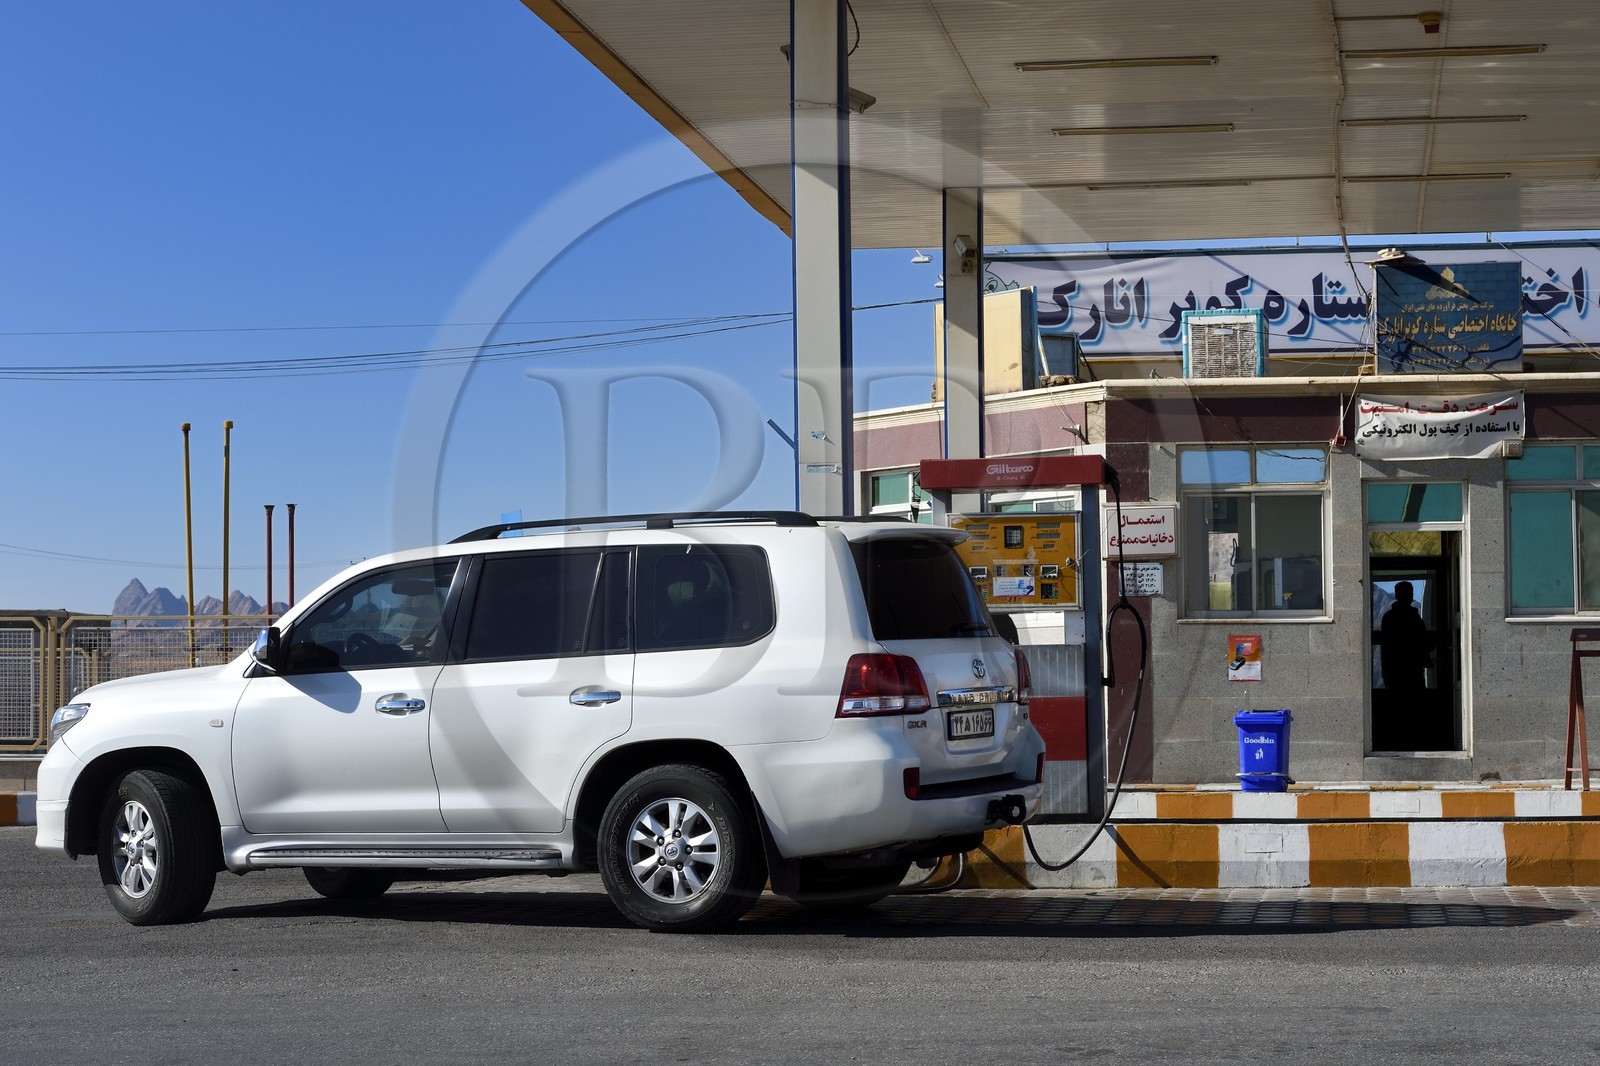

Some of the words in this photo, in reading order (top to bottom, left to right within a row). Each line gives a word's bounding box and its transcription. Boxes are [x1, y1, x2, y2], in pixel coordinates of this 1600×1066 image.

[1263, 272, 1367, 334] ستاره
[1402, 304, 1414, 313] ایران
[1426, 303, 1435, 312] های
[1423, 315, 1446, 340] ستاره
[1448, 313, 1488, 339] اختصاصی
[1490, 313, 1517, 336] جایگاه
[1362, 424, 1416, 438] الکترونیکی
[1419, 424, 1437, 438] پول
[1440, 423, 1460, 434] کیف
[1464, 424, 1473, 436] از
[1476, 422, 1510, 432] استفاده
[1512, 422, 1520, 434] با
[986, 464, 1034, 474] Gilbarco
[1120, 515, 1164, 528] استعمال
[1138, 533, 1174, 546] دخانیات
[907, 720, 927, 729] GXR
[1244, 735, 1274, 744] Goodbin
